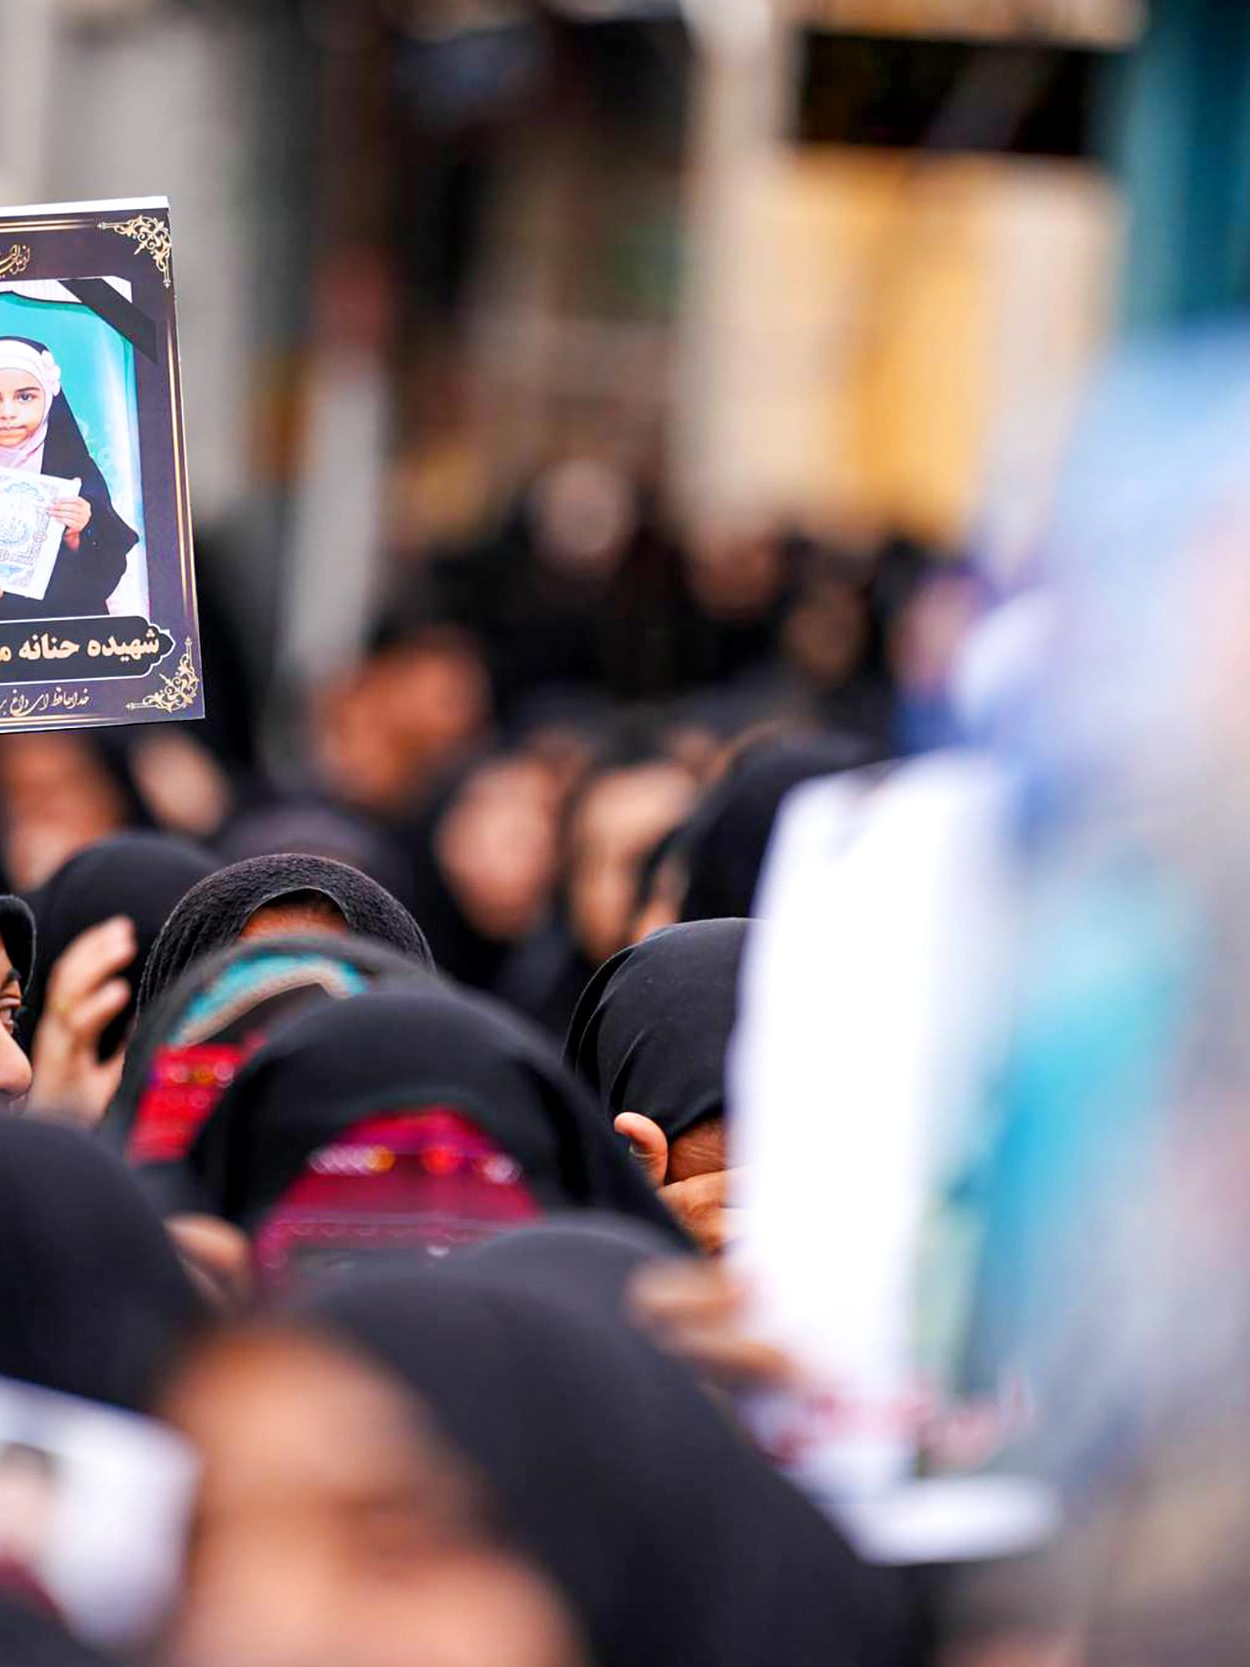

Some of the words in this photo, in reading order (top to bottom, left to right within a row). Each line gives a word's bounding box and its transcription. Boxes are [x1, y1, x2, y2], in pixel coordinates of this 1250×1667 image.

[18, 632, 81, 661] حنانه
[87, 628, 160, 662] شهیده
[51, 686, 90, 710] خداحافظ
